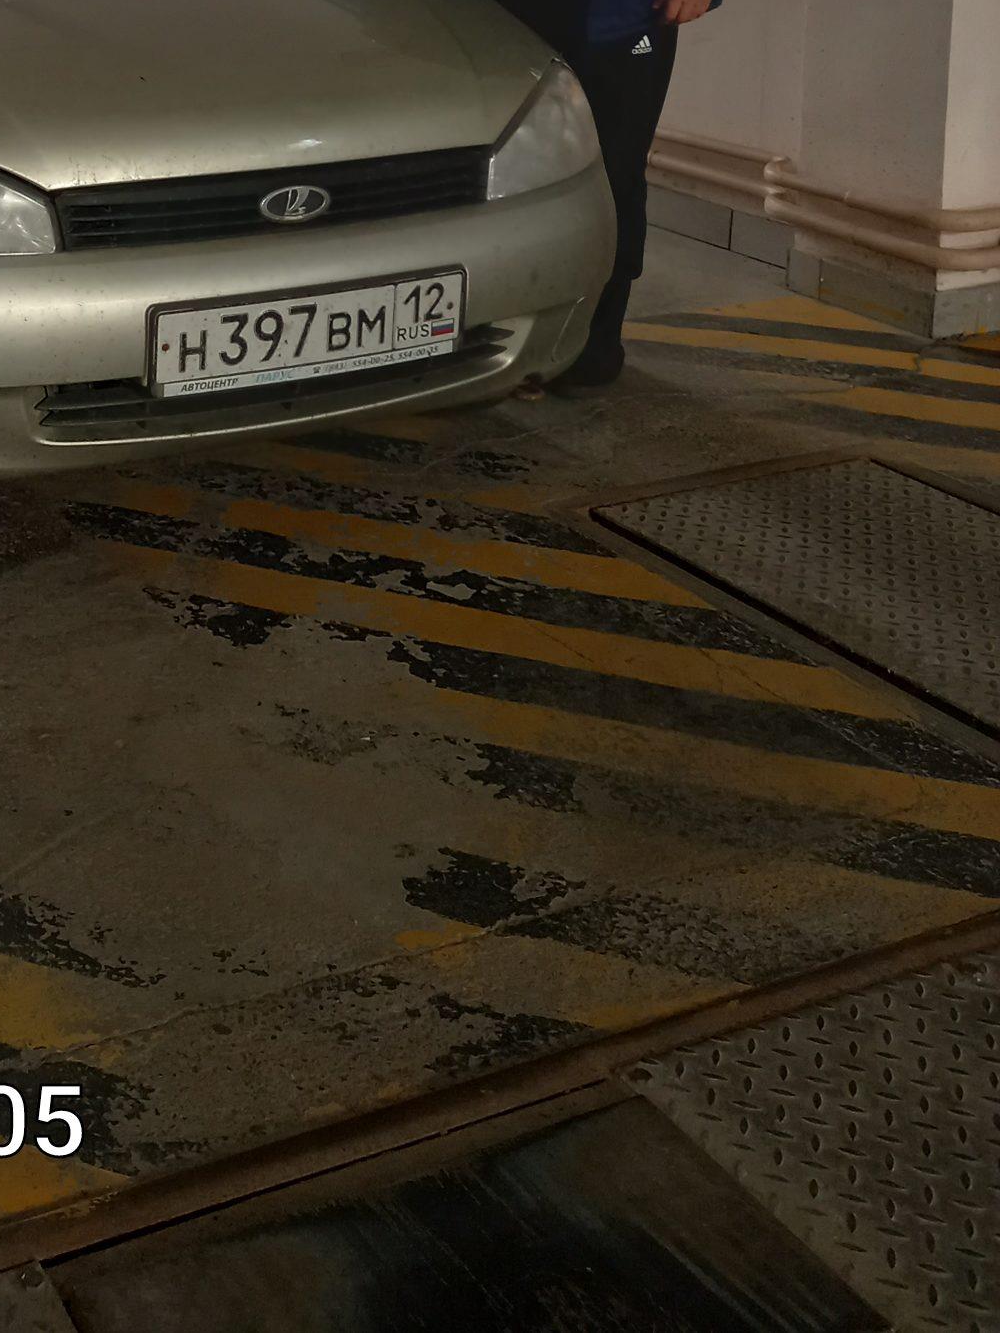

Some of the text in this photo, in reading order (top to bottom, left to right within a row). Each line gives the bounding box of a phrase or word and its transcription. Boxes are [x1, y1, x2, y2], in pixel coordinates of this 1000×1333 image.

[178, 281, 445, 373] Н397ВМ 12
[396, 323, 430, 342] RUS
[180, 377, 240, 393] АВТОЦЕНТР
[255, 368, 294, 383] ПАРУС
